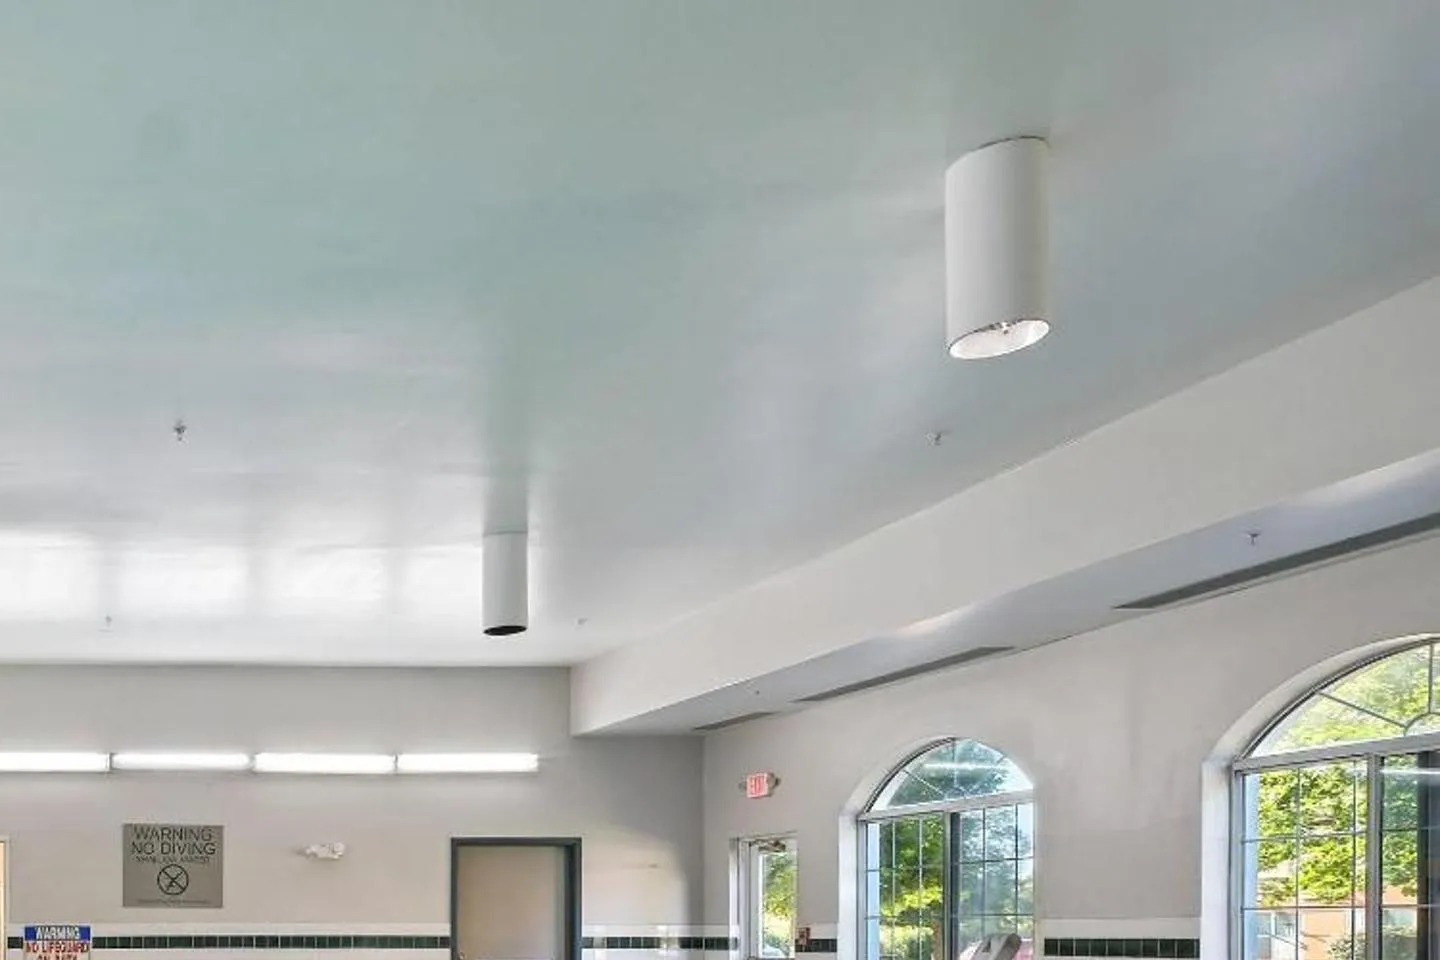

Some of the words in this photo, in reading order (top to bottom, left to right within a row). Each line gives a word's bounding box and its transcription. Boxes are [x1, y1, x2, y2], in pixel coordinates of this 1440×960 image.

[133, 826, 213, 841] WARNING
[131, 841, 156, 855] NO
[160, 841, 216, 855] DIVING
